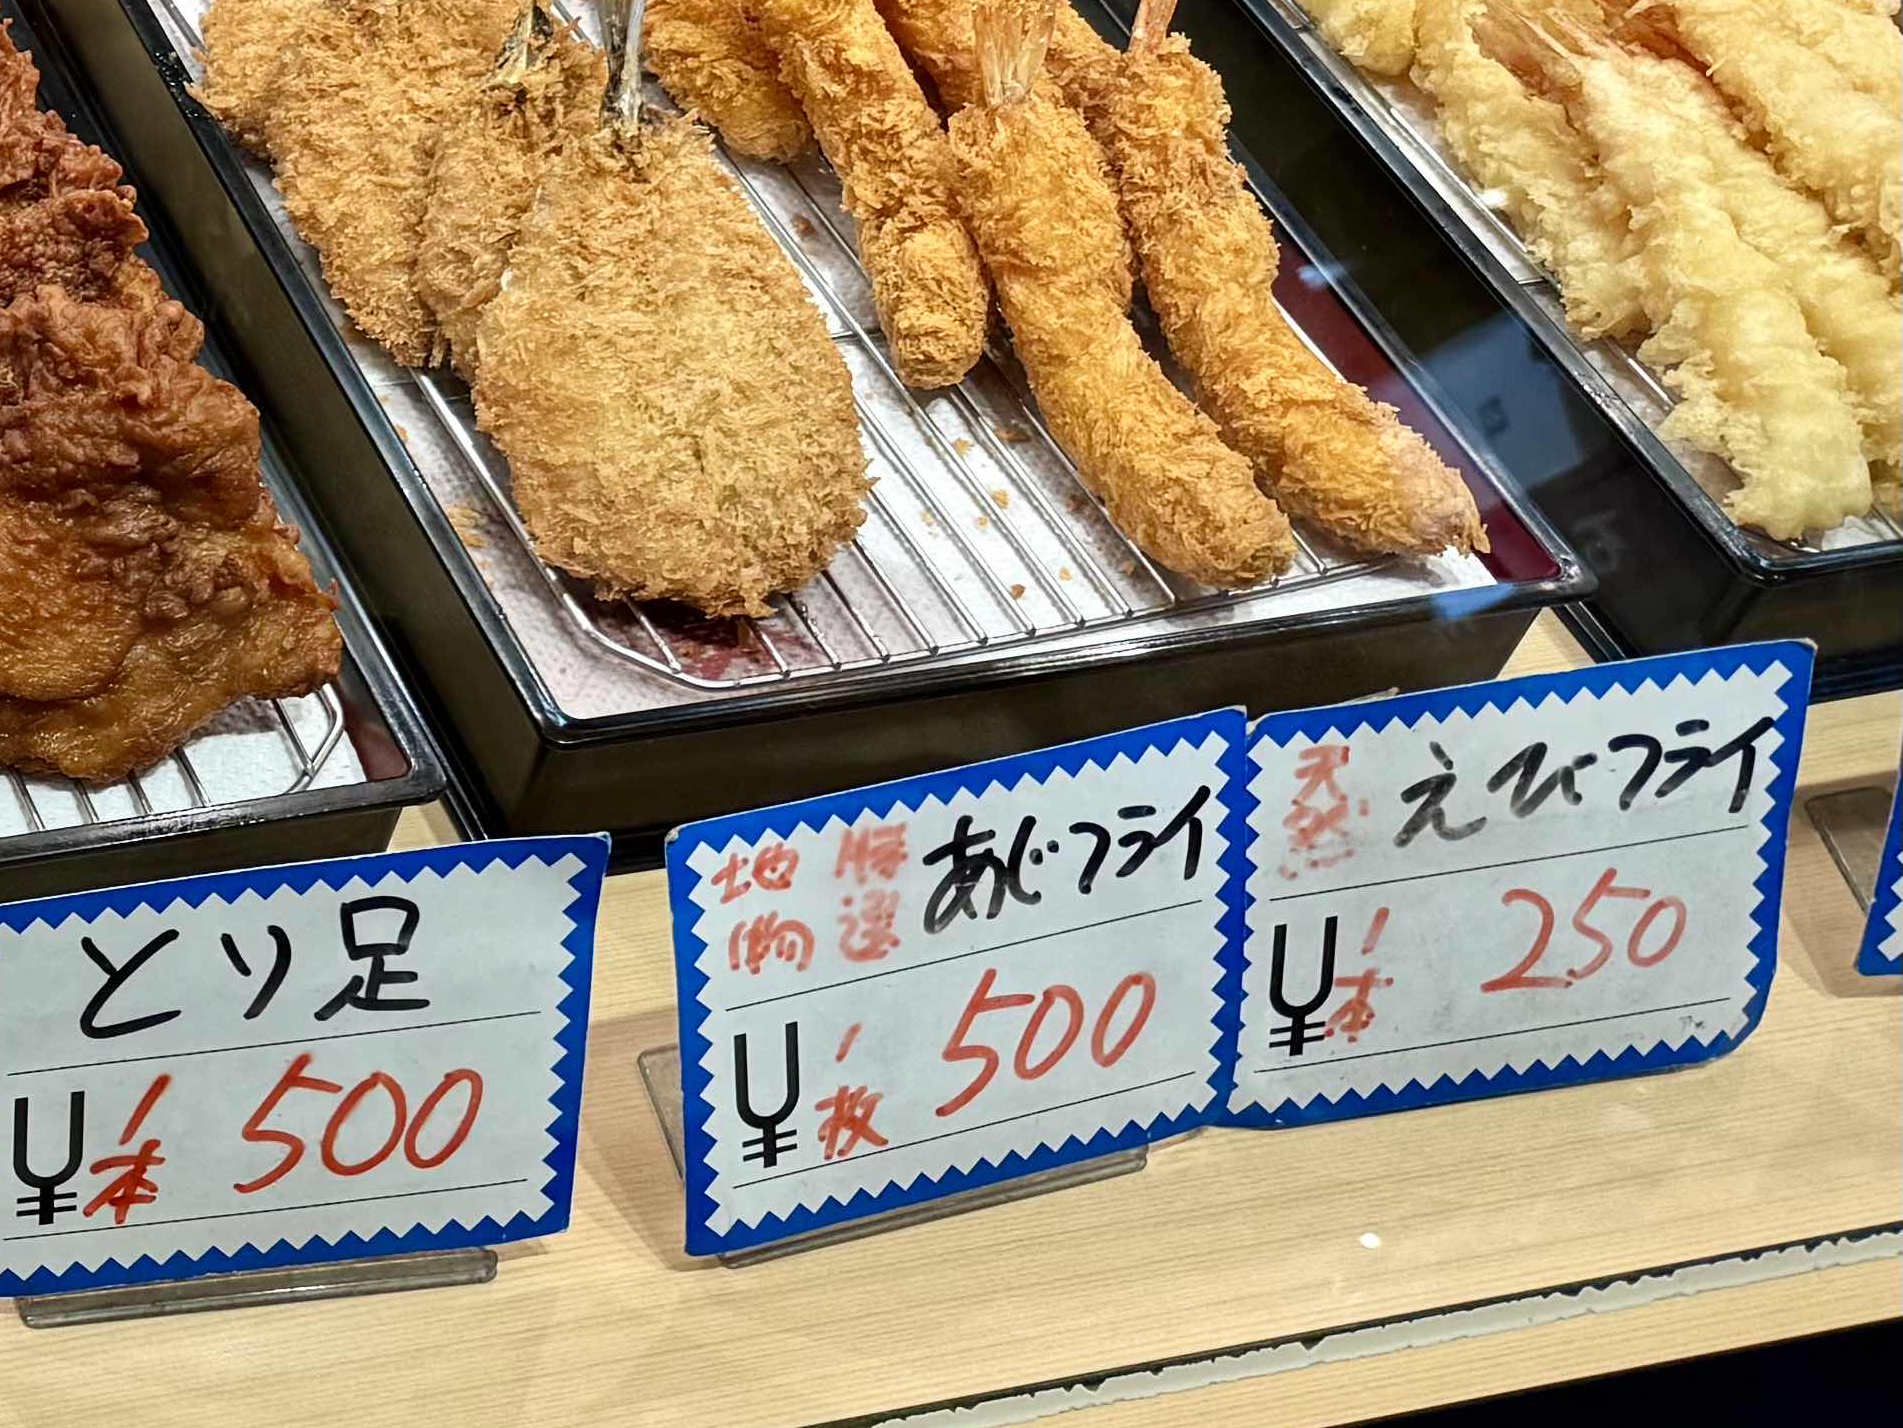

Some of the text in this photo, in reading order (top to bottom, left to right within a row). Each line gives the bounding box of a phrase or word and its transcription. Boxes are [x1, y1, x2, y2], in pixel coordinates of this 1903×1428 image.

[1394, 717, 1775, 848] えびフライ
[922, 785, 1212, 935] あじフライ
[1480, 868, 1688, 994] 250
[80, 895, 430, 1040] とり足
[936, 969, 1156, 1117] 500
[233, 1053, 484, 1195] 500
